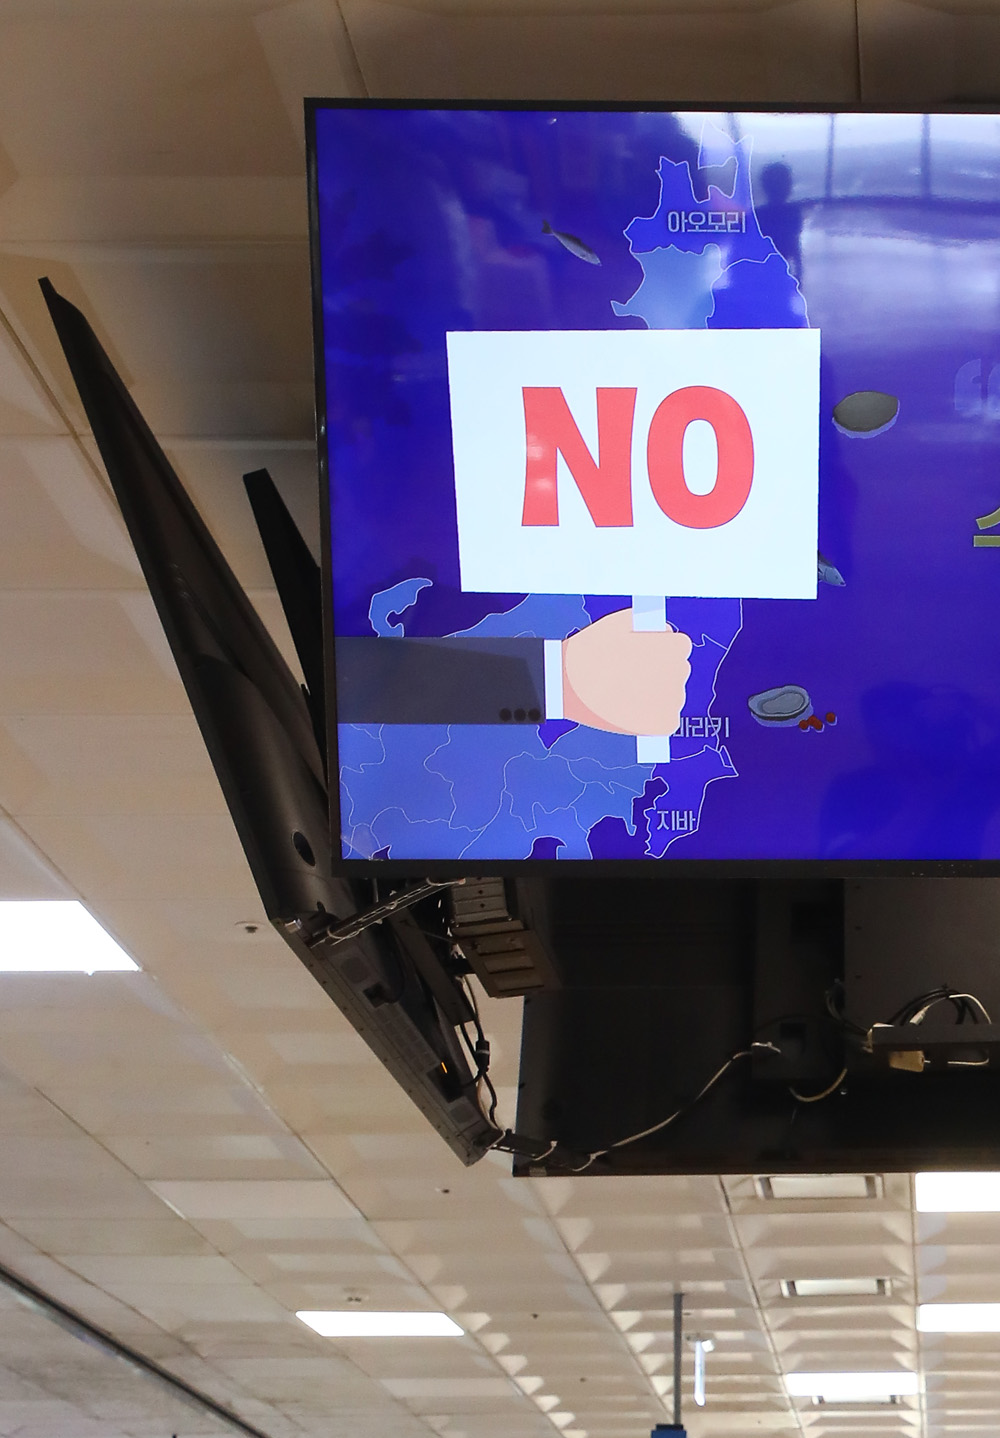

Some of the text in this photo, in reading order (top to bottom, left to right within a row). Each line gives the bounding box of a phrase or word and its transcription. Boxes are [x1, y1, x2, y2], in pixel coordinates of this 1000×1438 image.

[668, 211, 746, 233] 아오모리
[521, 385, 755, 529] NO
[656, 810, 696, 831] 지바
